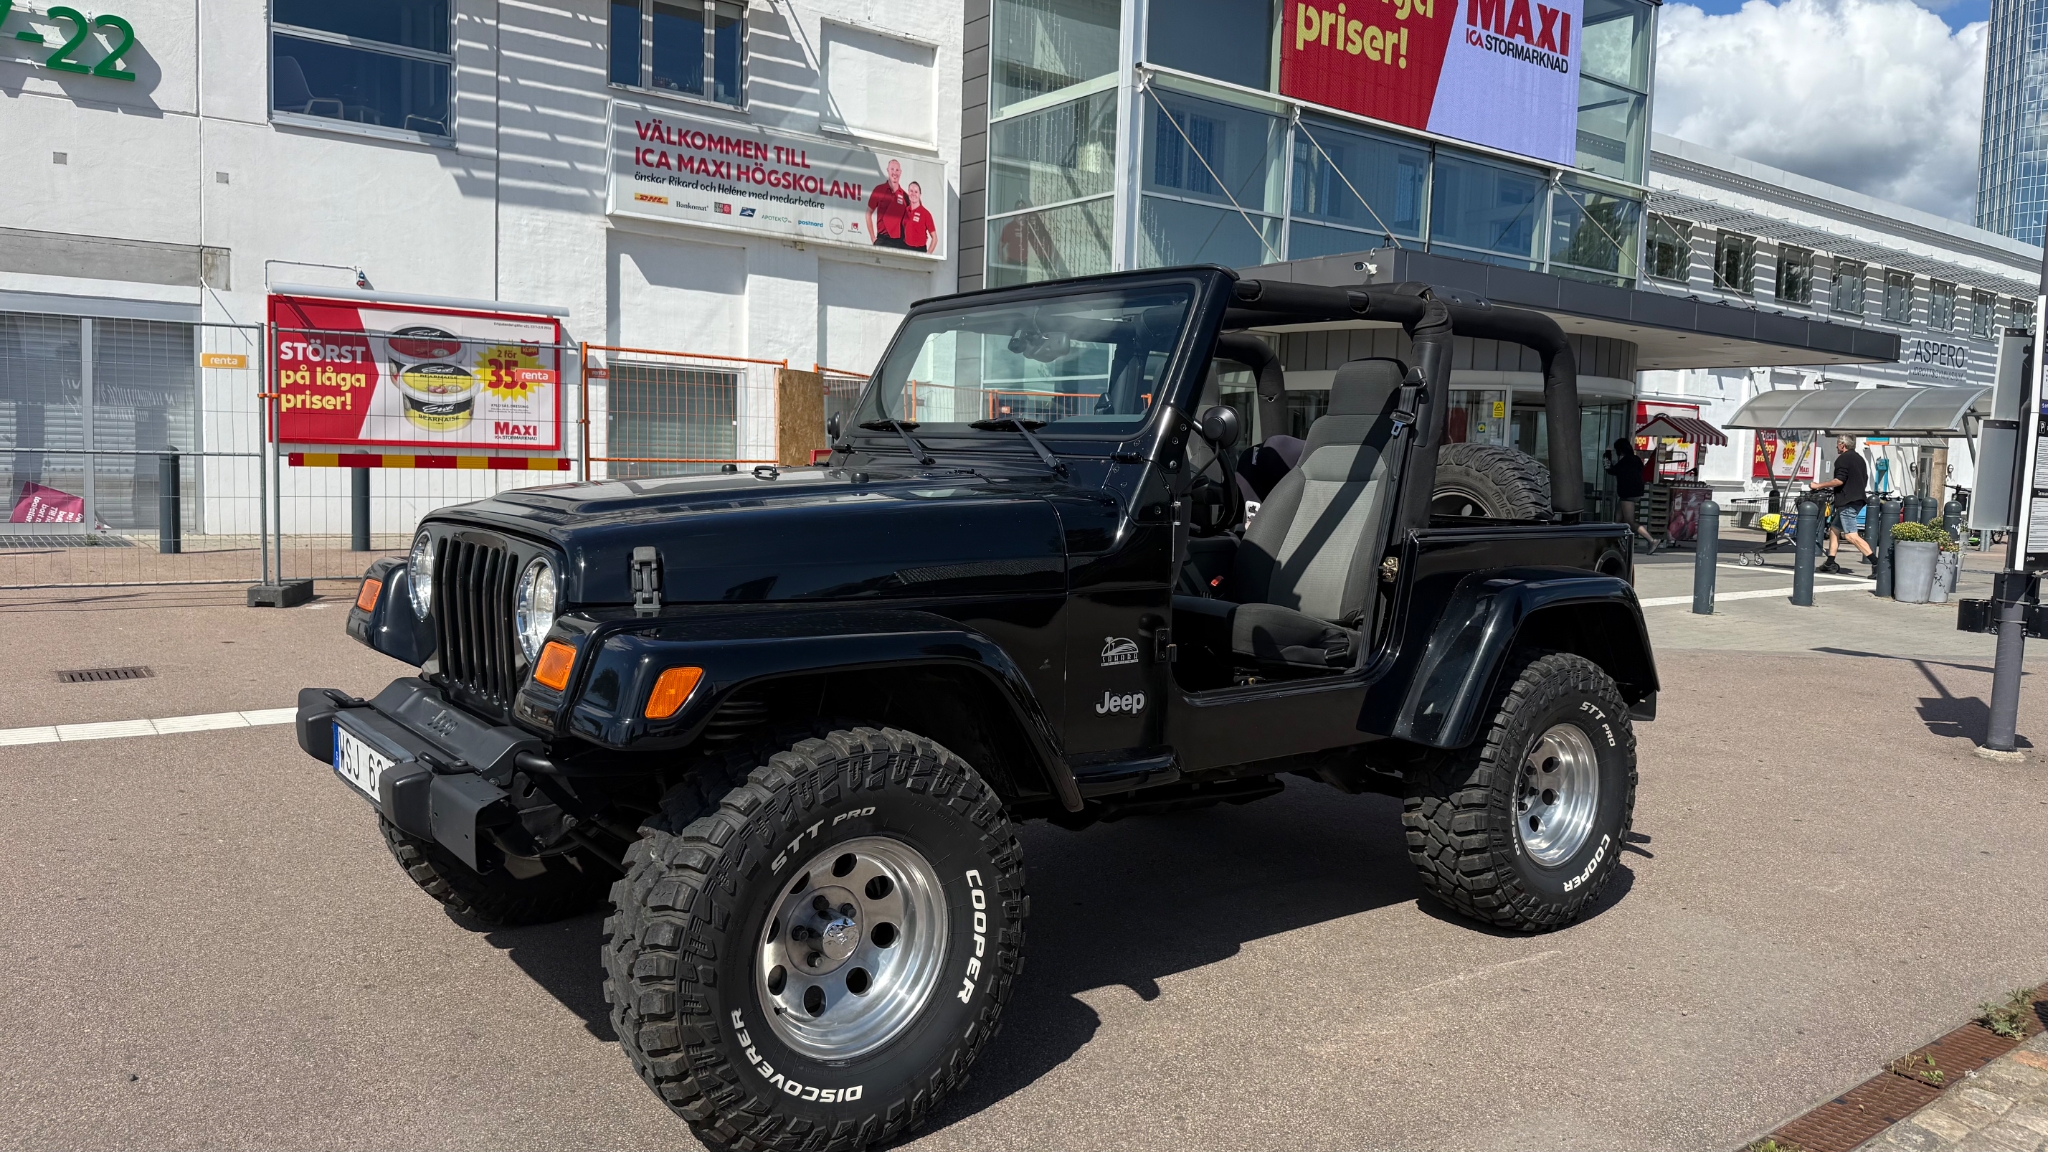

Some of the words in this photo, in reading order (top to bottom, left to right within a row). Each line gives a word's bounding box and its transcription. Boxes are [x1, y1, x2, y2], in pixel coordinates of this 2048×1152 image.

[1296, 2, 1408, 69] priser!
[1466, 27, 1484, 49] ICA
[1485, 34, 1569, 74] STORMARKNAD
[635, 118, 768, 162] VÄLKOMMEN
[773, 145, 811, 169] TILL
[635, 146, 672, 171] ICA
[677, 153, 732, 180] MAXI
[736, 161, 862, 202] HÖGSKOLAN!
[634, 171, 667, 185] önskar
[668, 175, 699, 191] Rikard
[699, 181, 718, 194] och
[717, 183, 748, 198] Heléne
[748, 189, 769, 201] med
[769, 192, 825, 210] medarbetare
[639, 194, 664, 205] DHL
[797, 219, 824, 229] postnord
[210, 356, 238, 365] renta
[280, 338, 366, 364] STÖRST
[497, 350, 503, 358] 2
[504, 349, 517, 359] för
[1914, 340, 1965, 368] ASPERO
[280, 364, 311, 388] på
[316, 365, 366, 391] låga
[522, 372, 549, 380] renta
[281, 389, 352, 413] priser!
[418, 414, 460, 423] BEARNAISE
[494, 422, 537, 436] MAXI
[1095, 691, 1145, 714] Jeep
[1579, 701, 1606, 720] STT
[1601, 723, 1616, 747] PRO
[339, 731, 360, 781] WSJ
[771, 818, 825, 876] STT
[832, 806, 877, 827] PRO
[1563, 834, 1611, 892] COOPER
[957, 869, 987, 1004] COOPER
[731, 1007, 864, 1103] DISCOVERER
